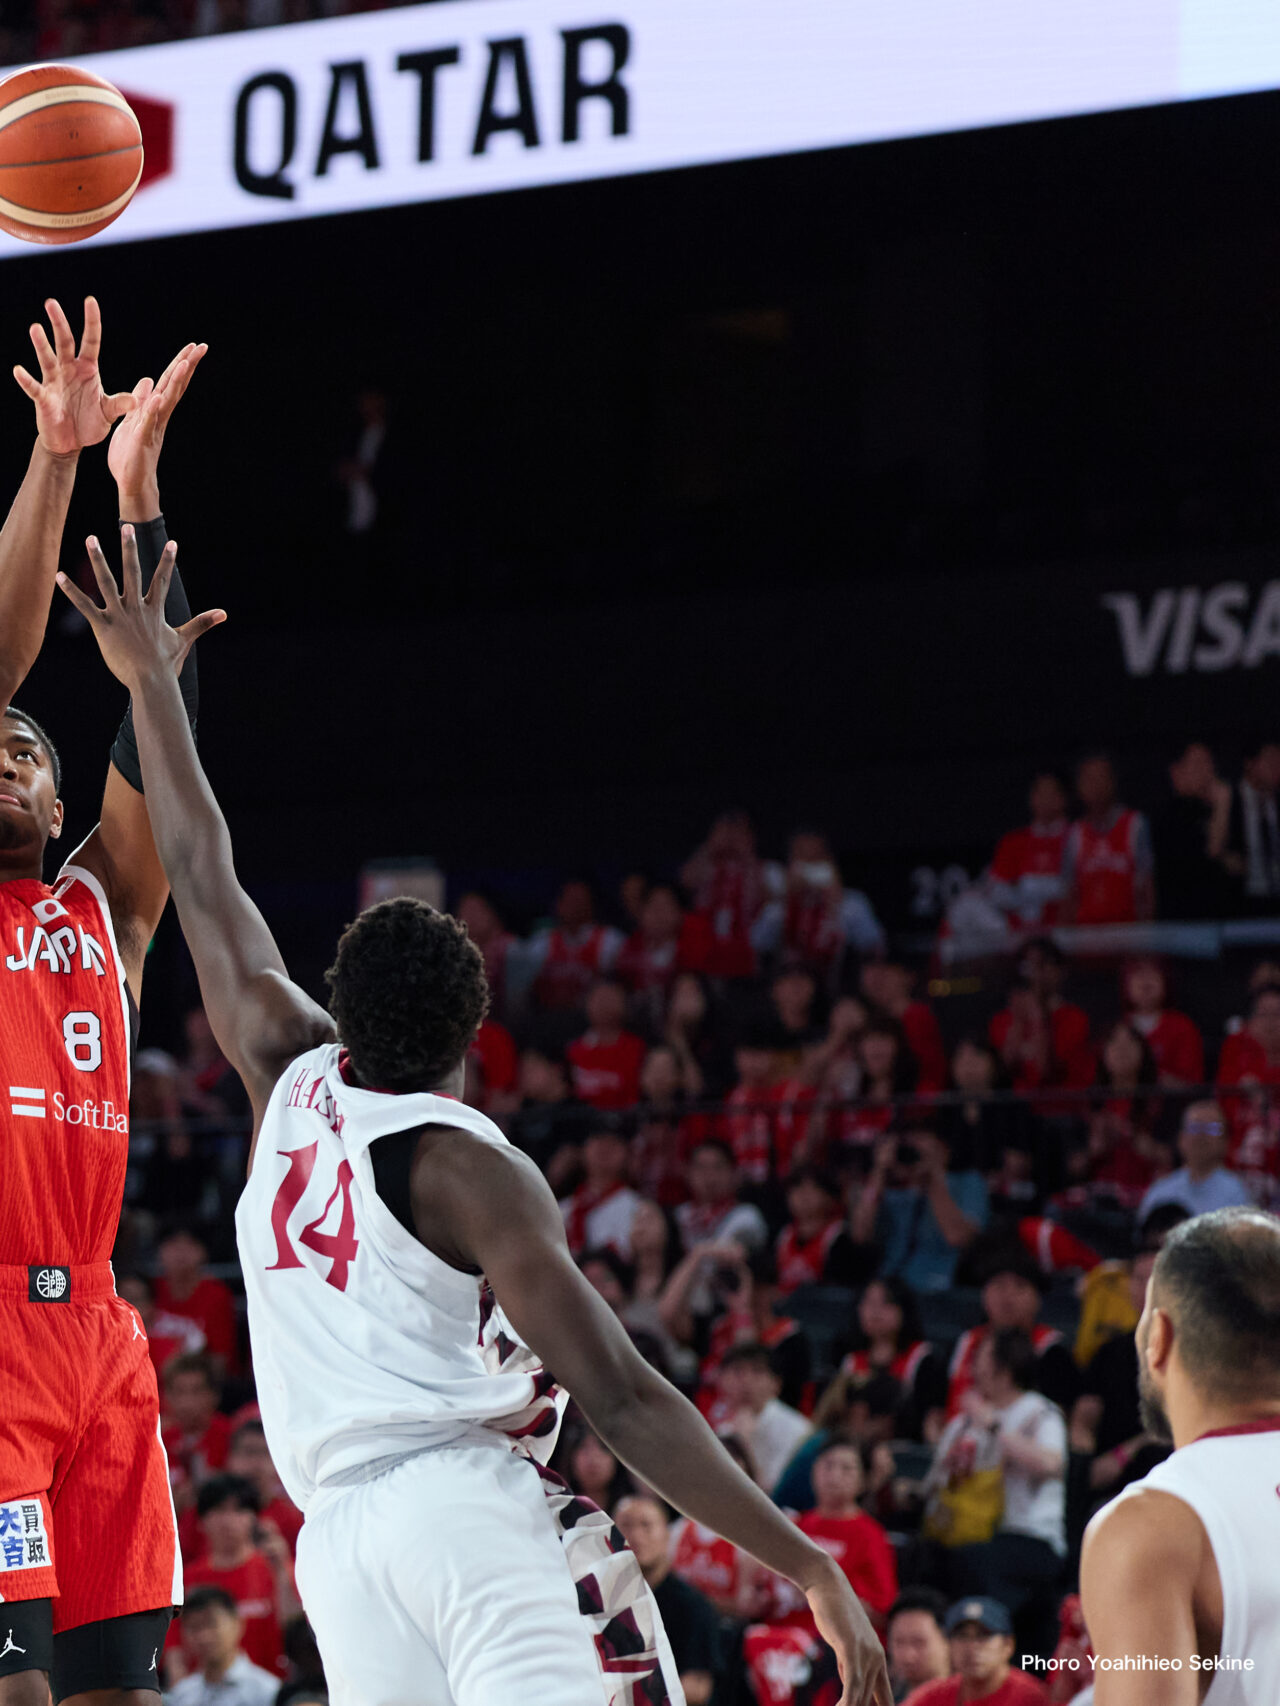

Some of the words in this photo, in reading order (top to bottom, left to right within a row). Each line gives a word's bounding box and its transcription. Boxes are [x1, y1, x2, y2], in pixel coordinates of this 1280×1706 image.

[232, 22, 632, 200] QATAR
[62, 1010, 102, 1072] 8
[265, 1139, 360, 1292] 14
[21, 1504, 46, 1563] 買取
